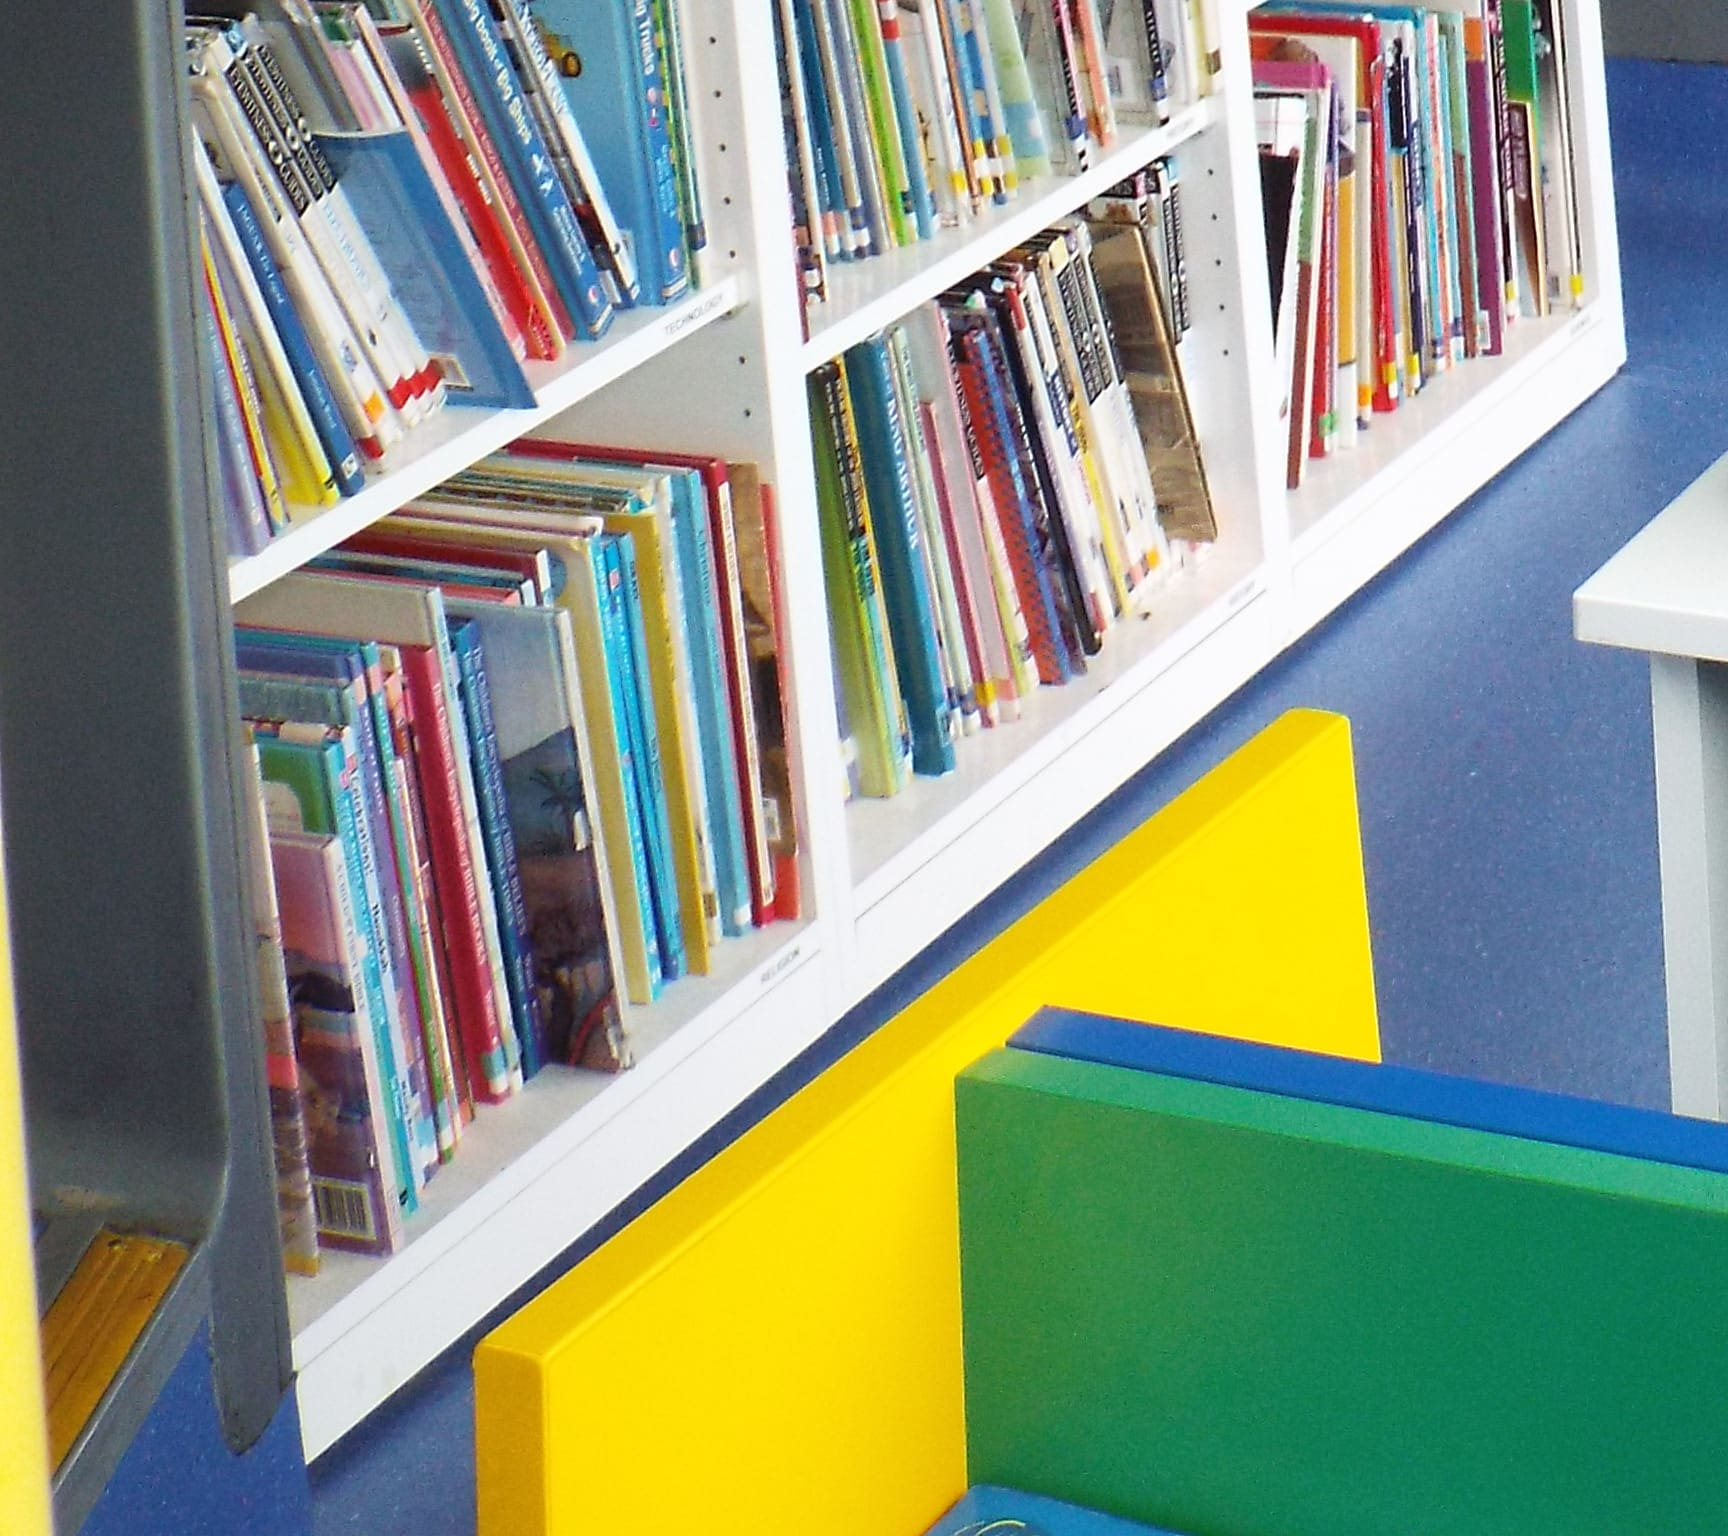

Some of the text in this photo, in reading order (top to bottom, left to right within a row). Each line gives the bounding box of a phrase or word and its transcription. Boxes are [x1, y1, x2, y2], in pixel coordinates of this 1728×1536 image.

[472, 16, 501, 60] book
[493, 70, 516, 100] Big
[505, 96, 536, 145] Ships
[636, 16, 657, 75] Trucks
[226, 64, 309, 213] EYEWITNESS GUIDES
[246, 56, 325, 199] EYEWITNESS GUIDES
[256, 44, 338, 186] EYEWITNESS GUIDES
[664, 292, 724, 337] TECHNOLOGY
[886, 398, 905, 455] KING
[896, 460, 921, 551] ARTHUR
[431, 682, 443, 699] The
[444, 768, 469, 856] Encyclopedia
[471, 646, 484, 667] The
[501, 831, 517, 875] BIBLE
[509, 878, 527, 936] BELIEFS
[348, 771, 376, 877] Celebrations!
[370, 903, 391, 973] Hanukkah
[462, 867, 478, 907] BIBLE
[492, 835, 507, 874] BIBLE
[469, 910, 488, 964] BOOKS
[759, 945, 802, 986] RELIGION
